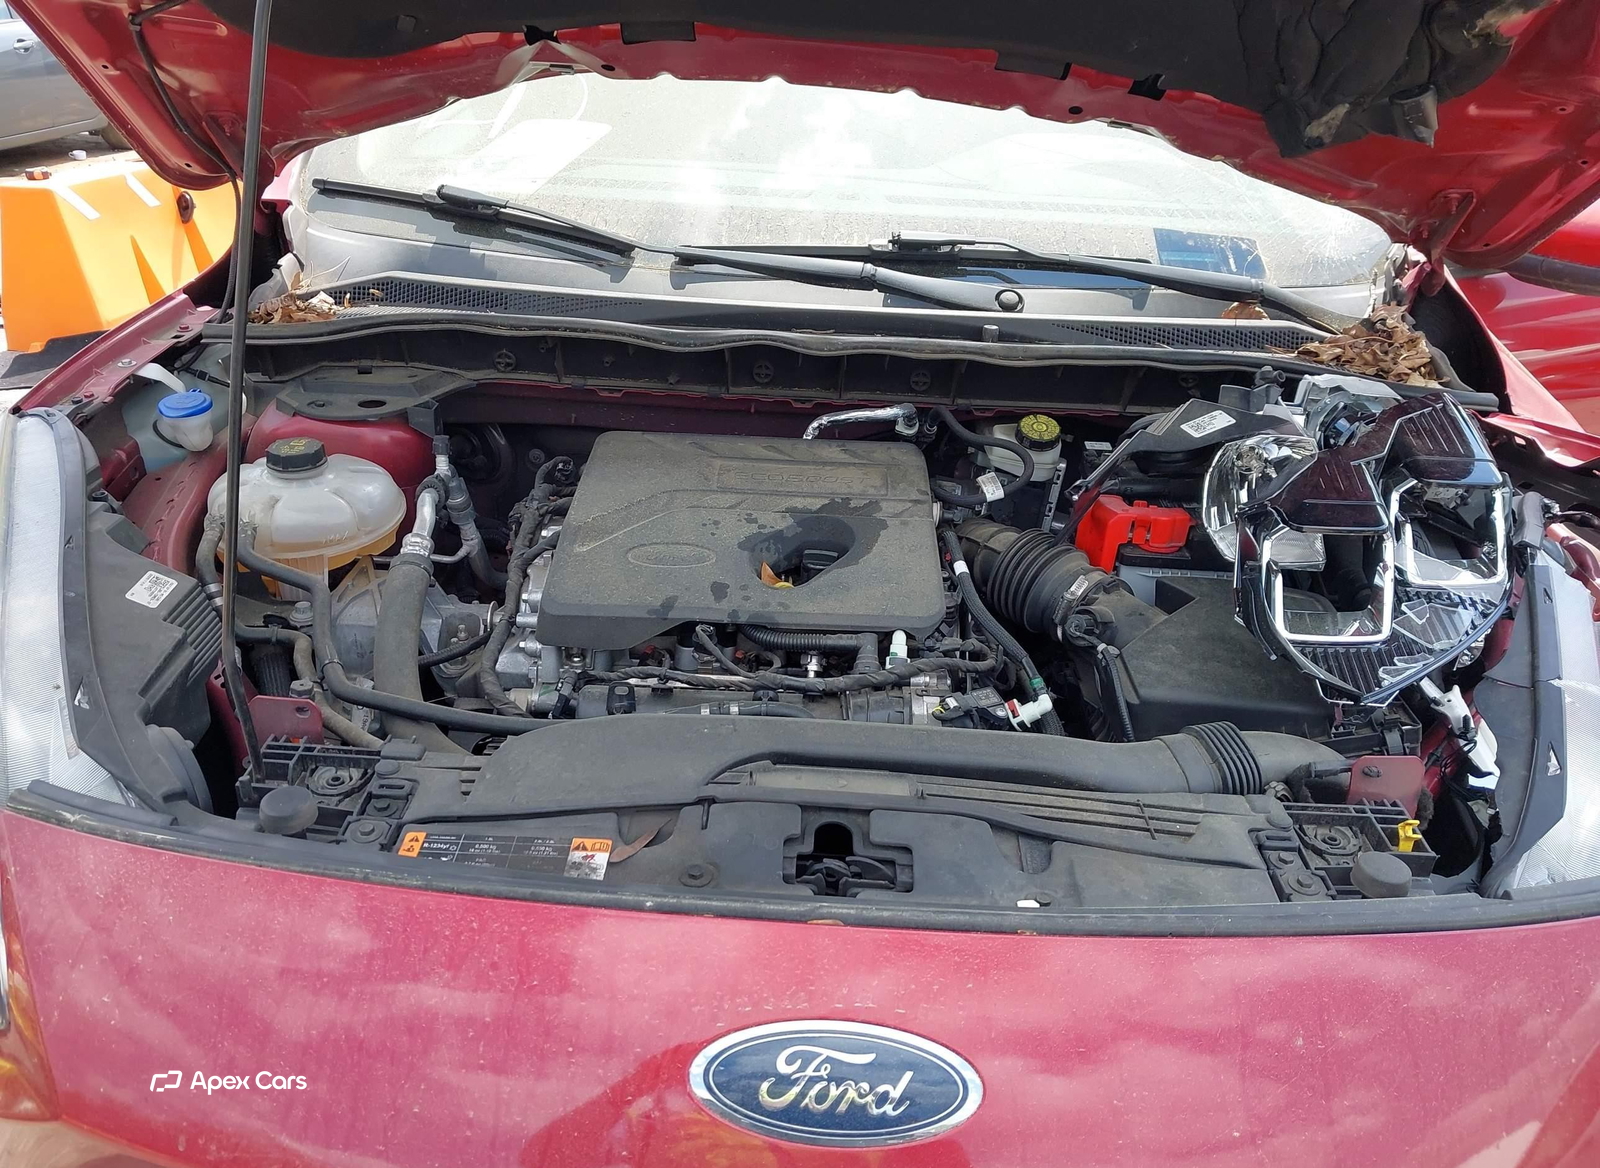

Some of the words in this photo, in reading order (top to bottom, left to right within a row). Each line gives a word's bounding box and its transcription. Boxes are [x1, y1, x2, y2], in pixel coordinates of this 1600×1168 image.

[733, 470, 872, 485] ECOBOOST
[422, 842, 450, 850] R-1234yf
[758, 1045, 914, 1117] Ford
